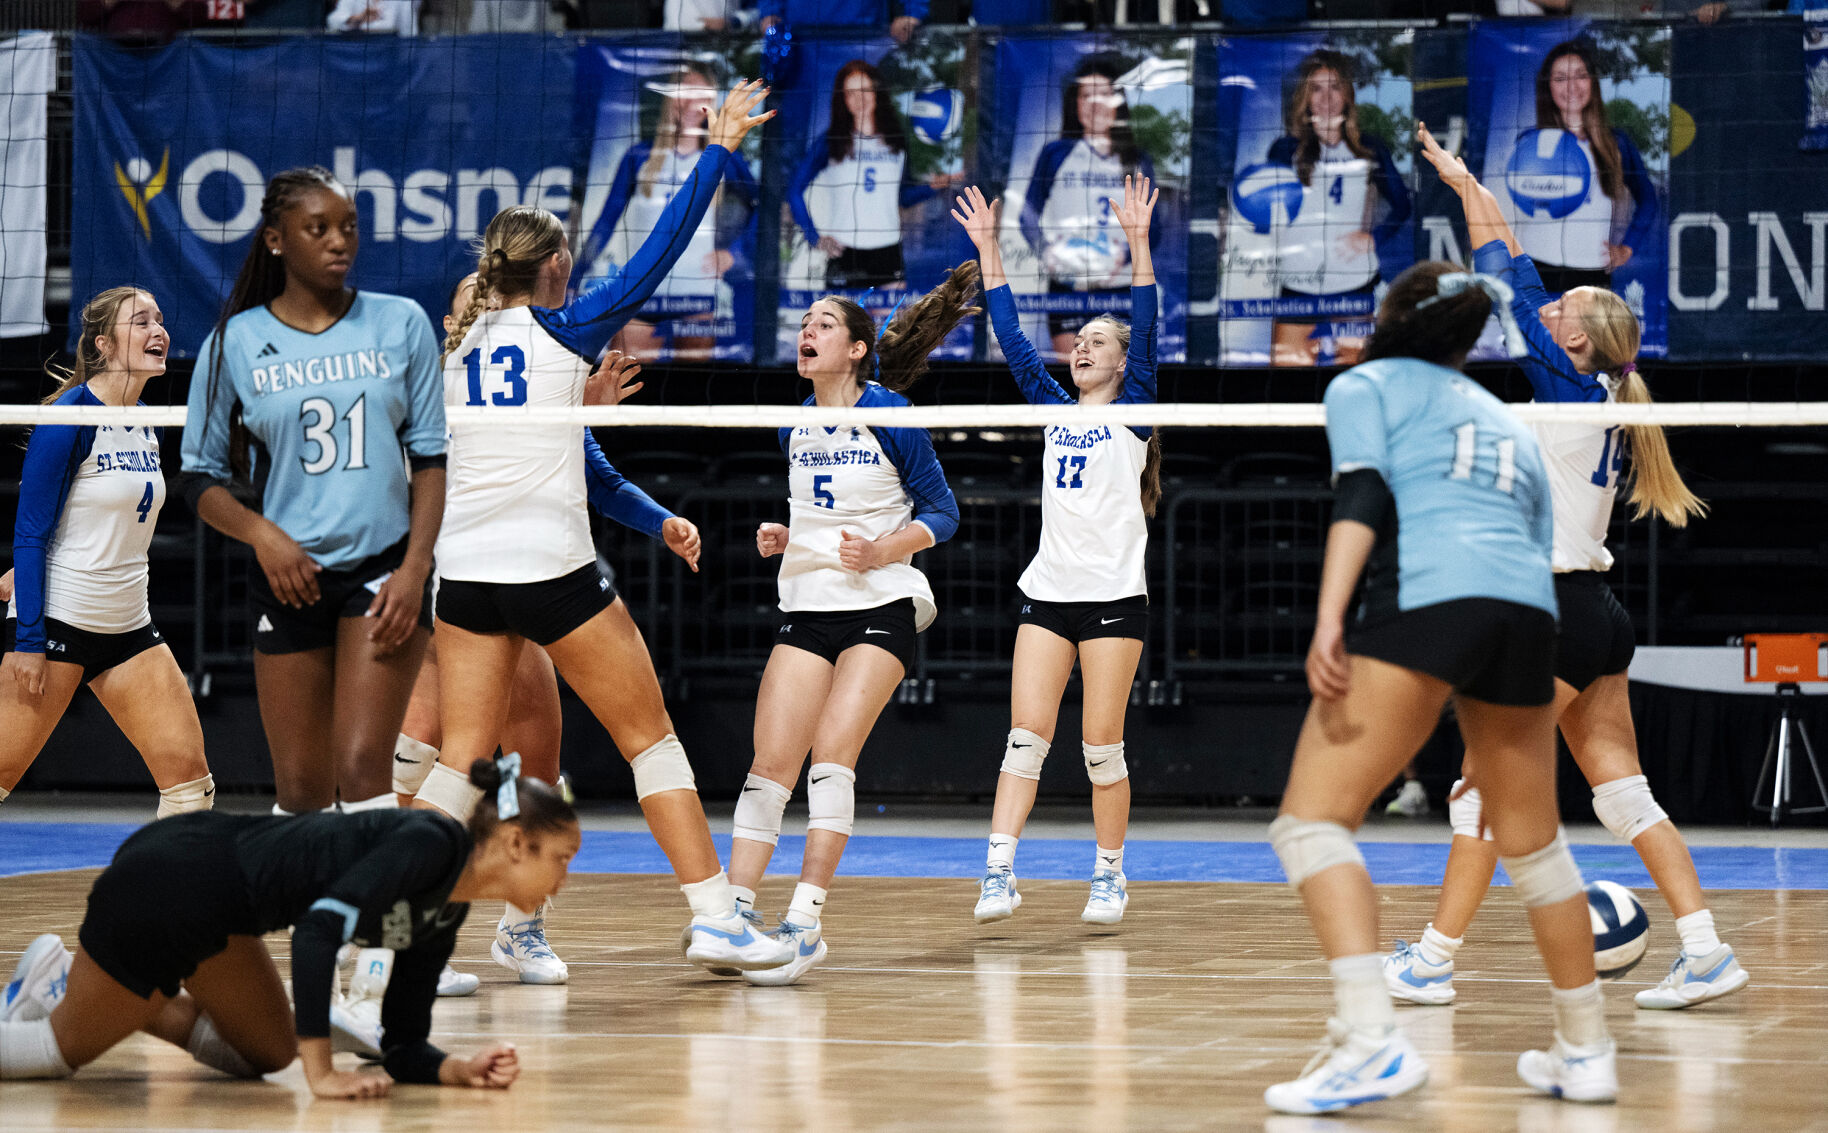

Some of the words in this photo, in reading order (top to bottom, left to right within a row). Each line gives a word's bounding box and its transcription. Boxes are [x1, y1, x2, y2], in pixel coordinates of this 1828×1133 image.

[208, 0, 245, 20] 121
[178, 146, 575, 245] Ohsne
[864, 167, 876, 193] 6
[1329, 174, 1343, 205] 4
[1098, 196, 1110, 227] 3
[251, 348, 392, 396] PENGUINS
[462, 344, 528, 407] 13
[299, 391, 369, 476] 31
[1056, 455, 1088, 489] 17
[1444, 418, 1518, 498] 11
[136, 481, 154, 523] 4
[813, 474, 835, 510] 5
